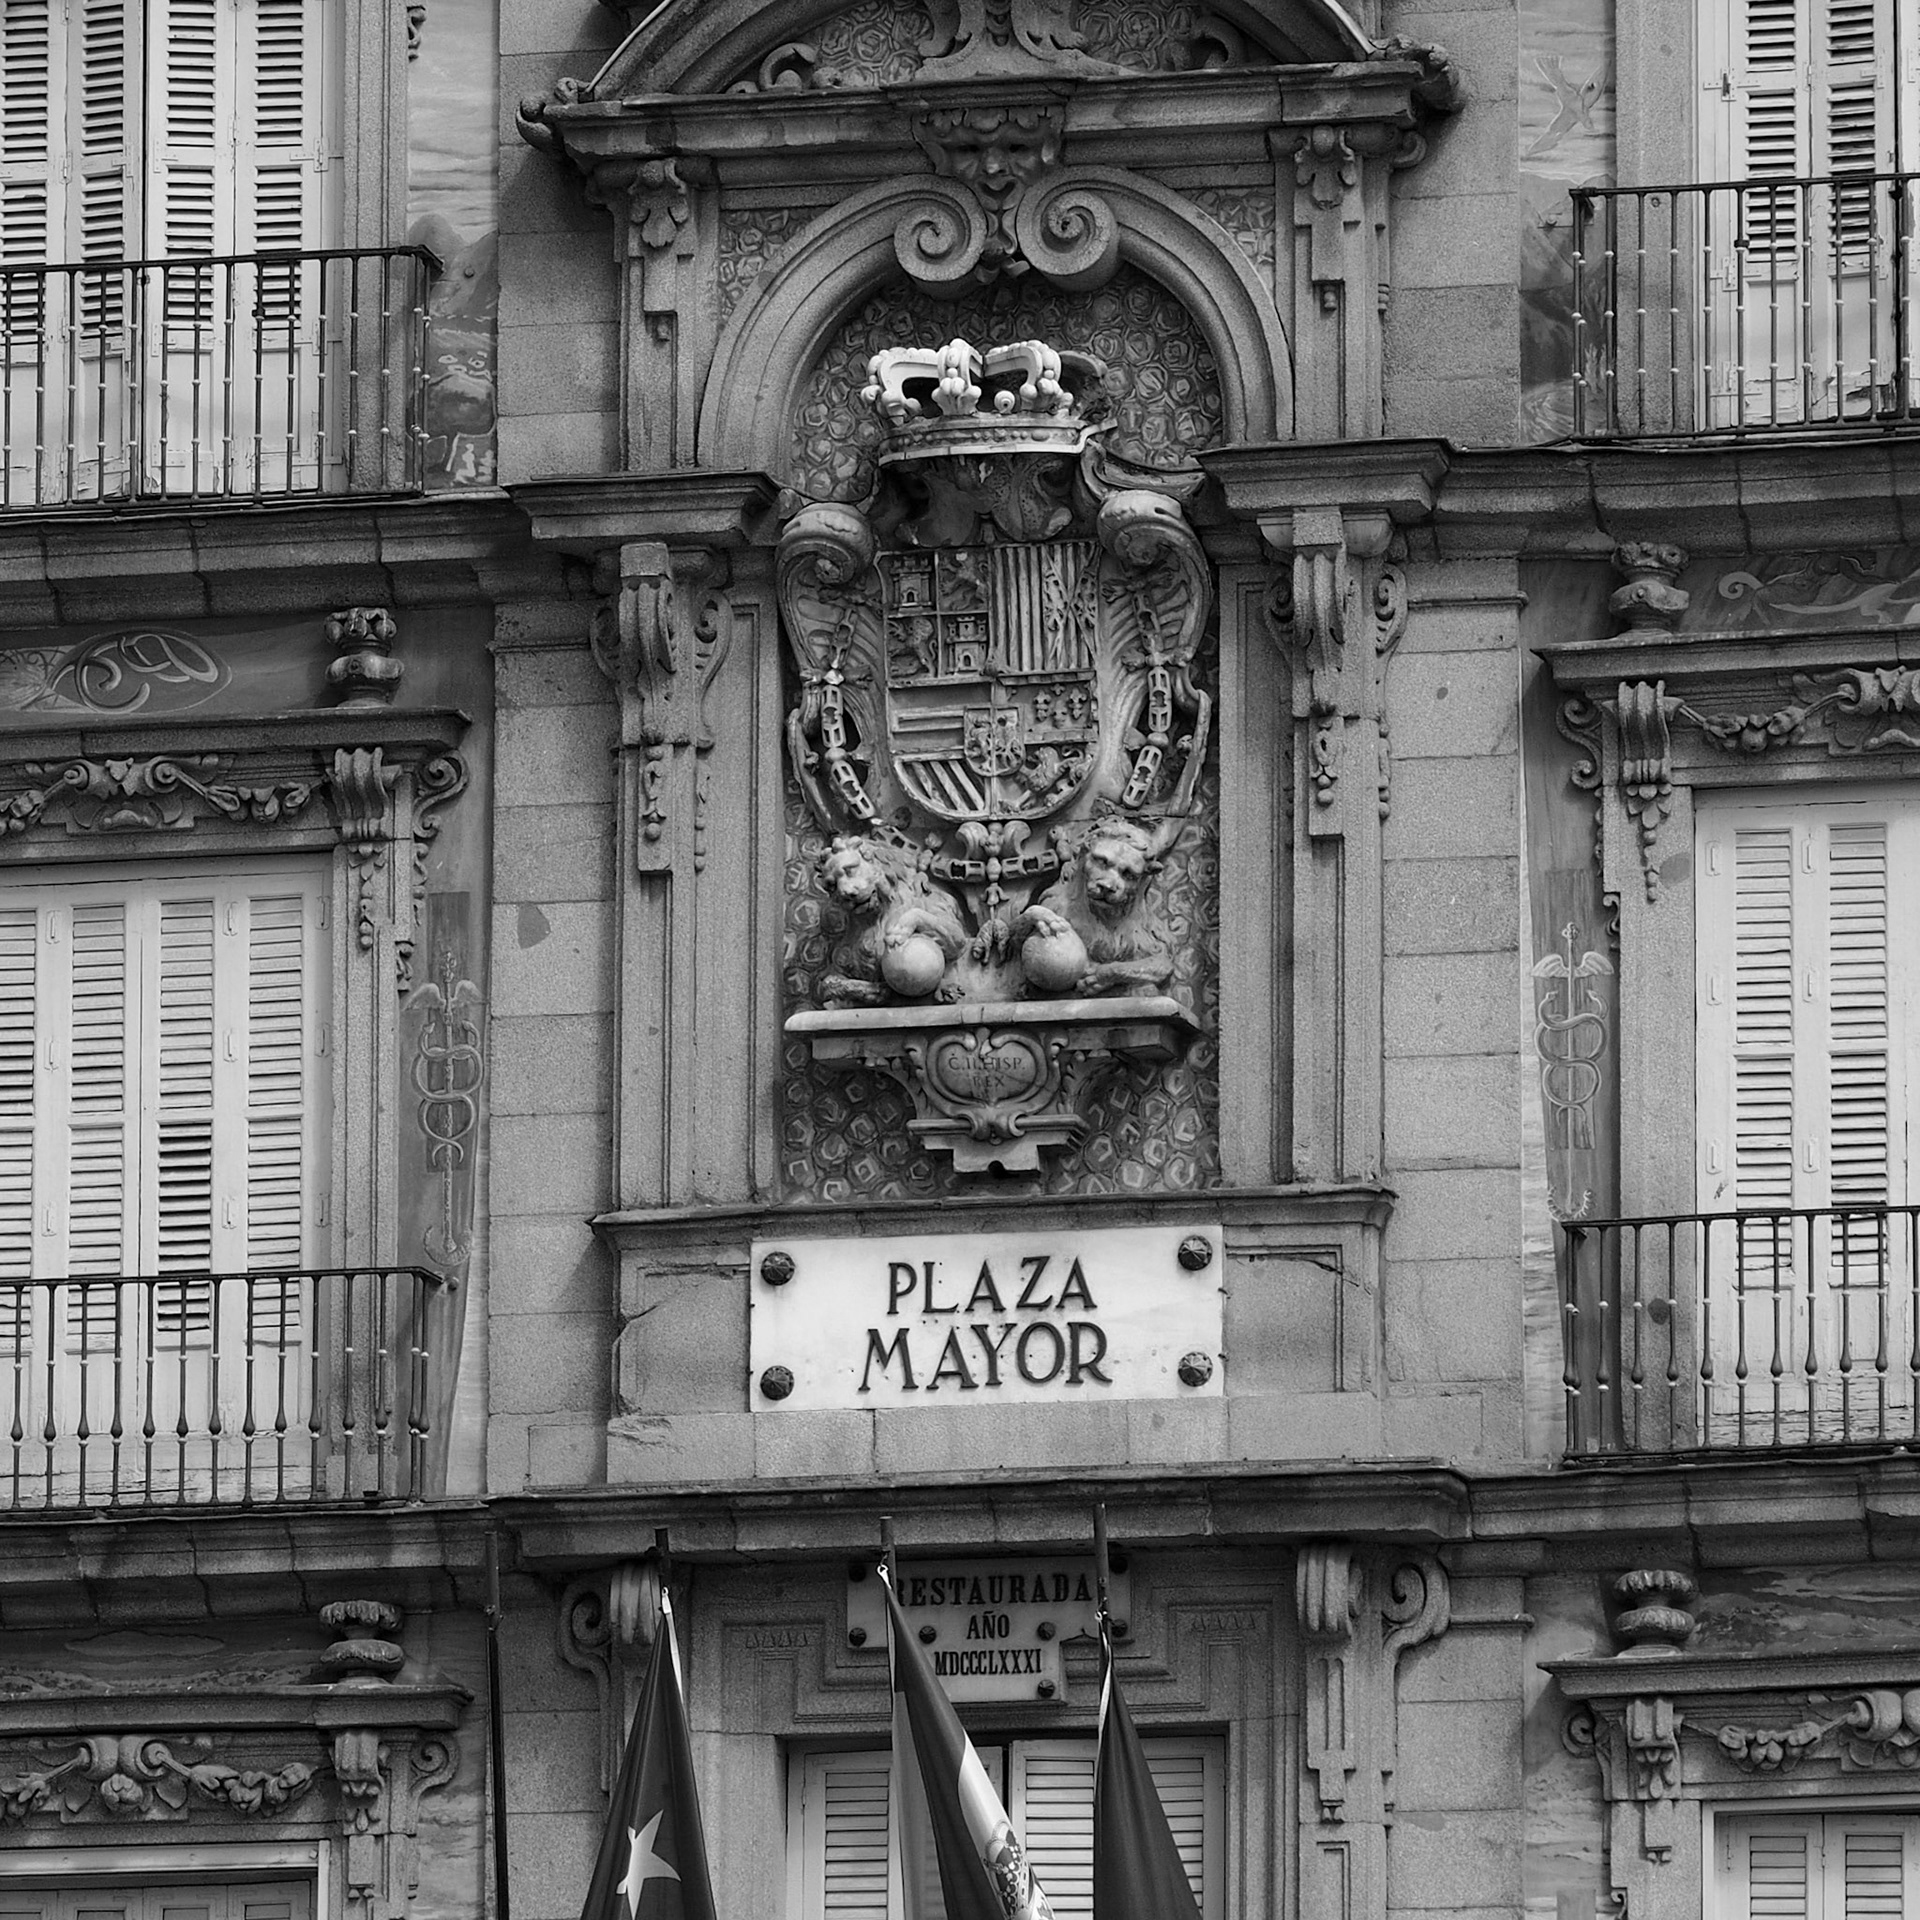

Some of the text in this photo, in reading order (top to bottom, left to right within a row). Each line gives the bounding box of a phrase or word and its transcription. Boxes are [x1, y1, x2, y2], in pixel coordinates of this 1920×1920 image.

[973, 1075, 1005, 1088] REX
[887, 1255, 1098, 1315] PLAZA
[858, 1321, 1114, 1393] MAYOR
[966, 1609, 1011, 1640] AÑO
[934, 1648, 1043, 1677] MDCCCLXXXI
